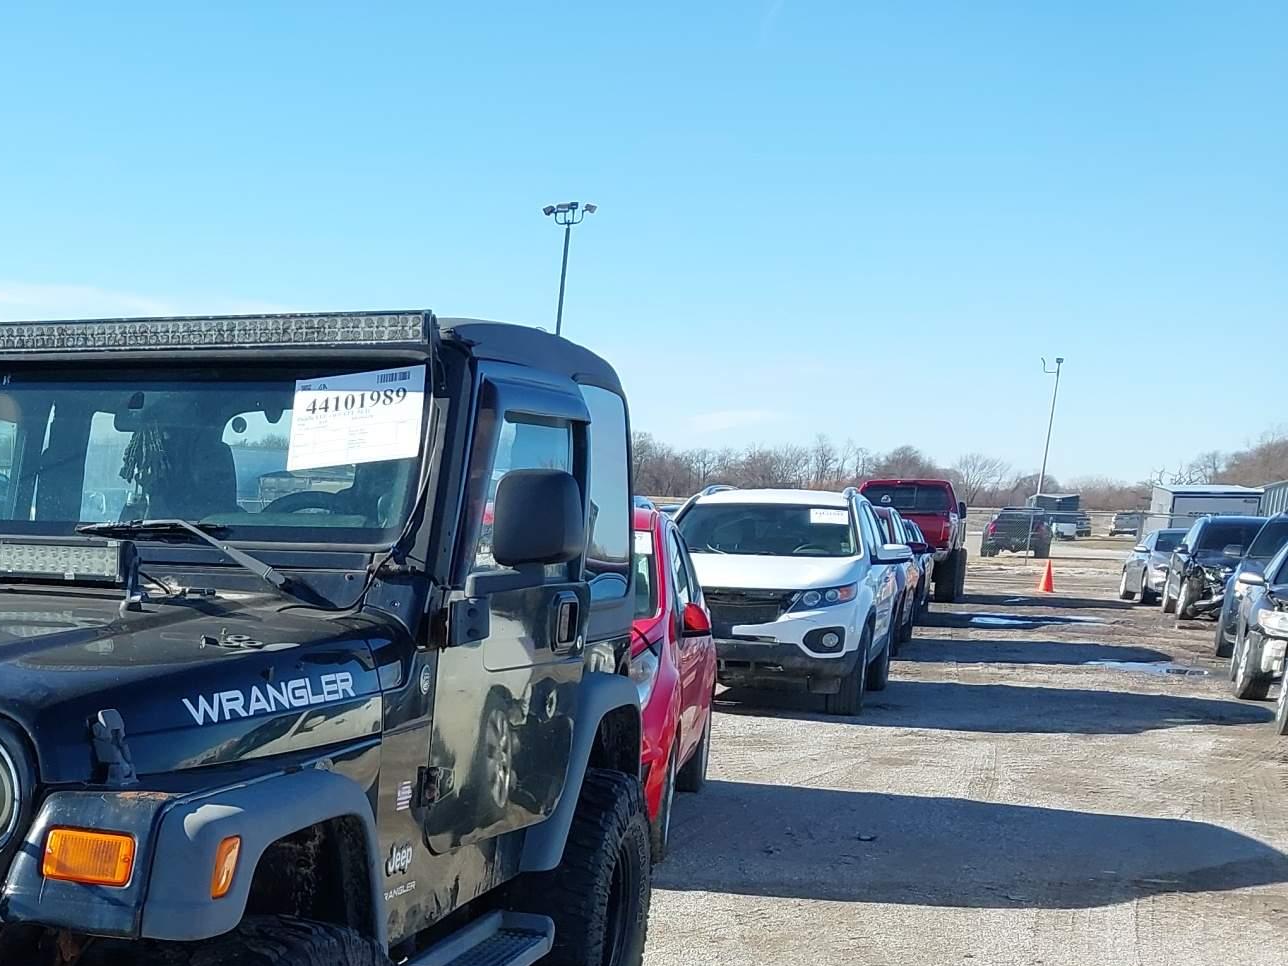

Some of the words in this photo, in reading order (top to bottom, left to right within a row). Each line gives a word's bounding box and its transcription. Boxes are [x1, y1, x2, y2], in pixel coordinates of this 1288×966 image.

[306, 387, 407, 414] 44101989
[182, 671, 357, 726] WRANGLER
[386, 844, 413, 876] Jeep
